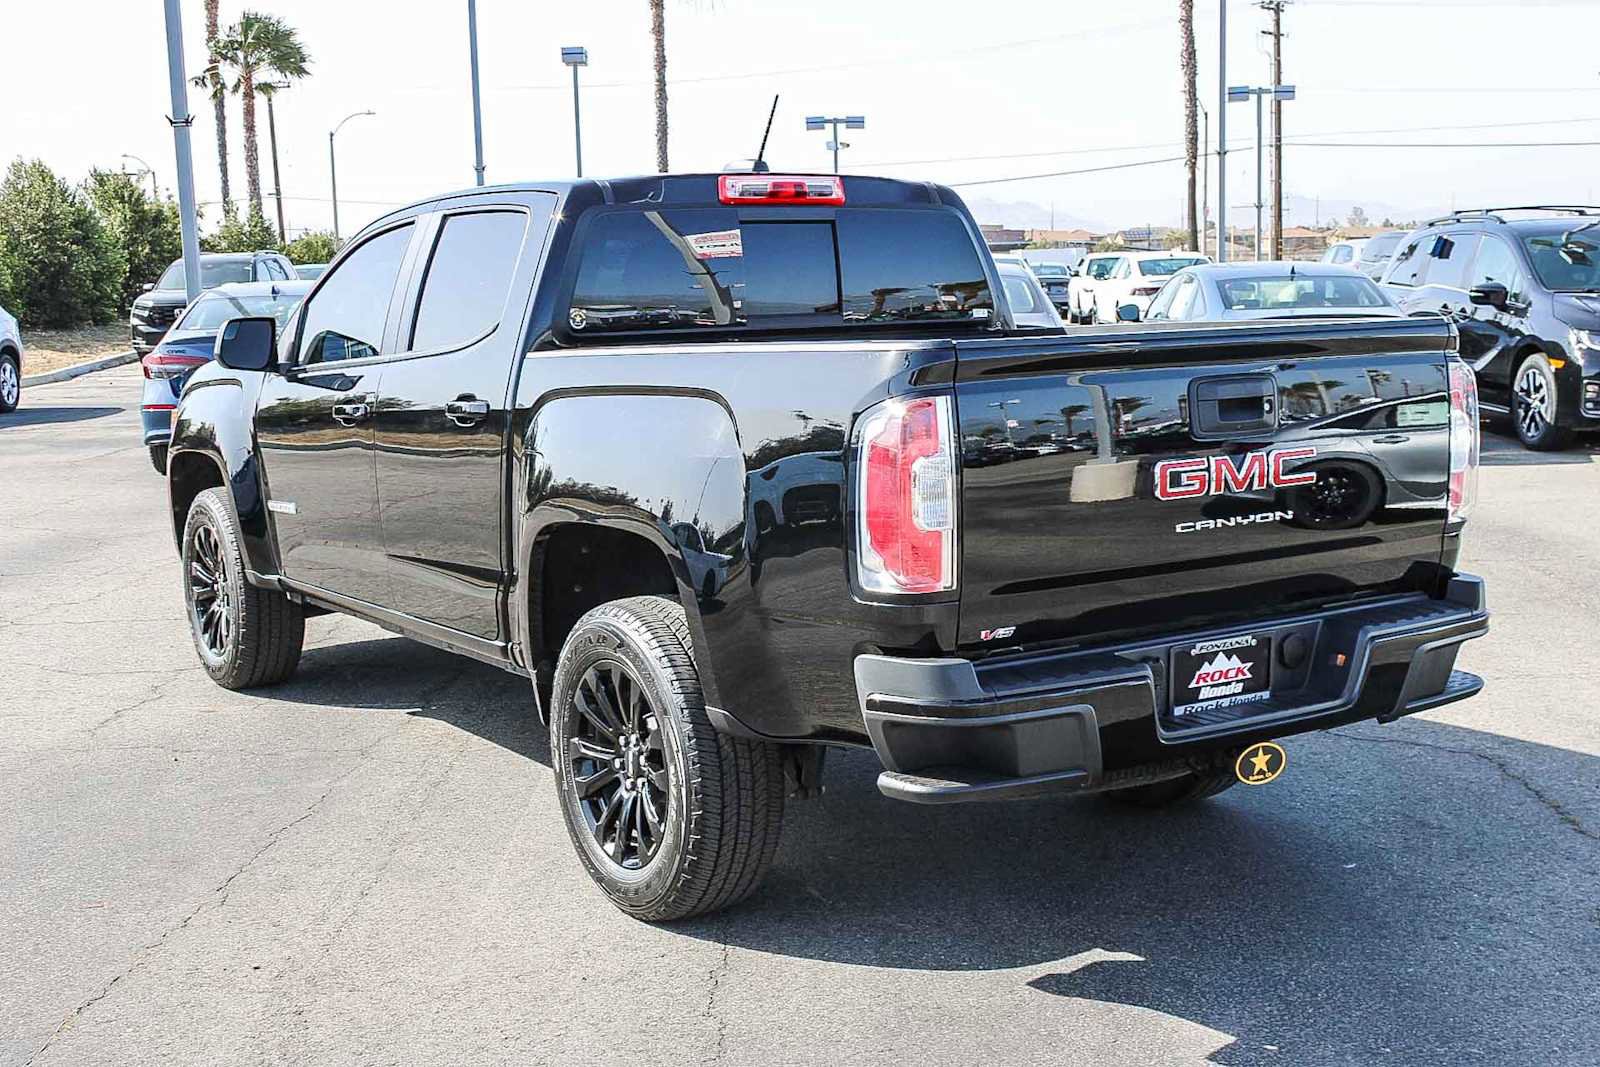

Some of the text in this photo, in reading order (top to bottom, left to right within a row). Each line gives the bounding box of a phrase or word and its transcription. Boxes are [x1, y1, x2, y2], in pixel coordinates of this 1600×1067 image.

[1154, 447, 1317, 501] GMC
[1175, 510, 1294, 533] CANYON
[1194, 666, 1248, 685] ROCK
[1198, 682, 1245, 700] Honda
